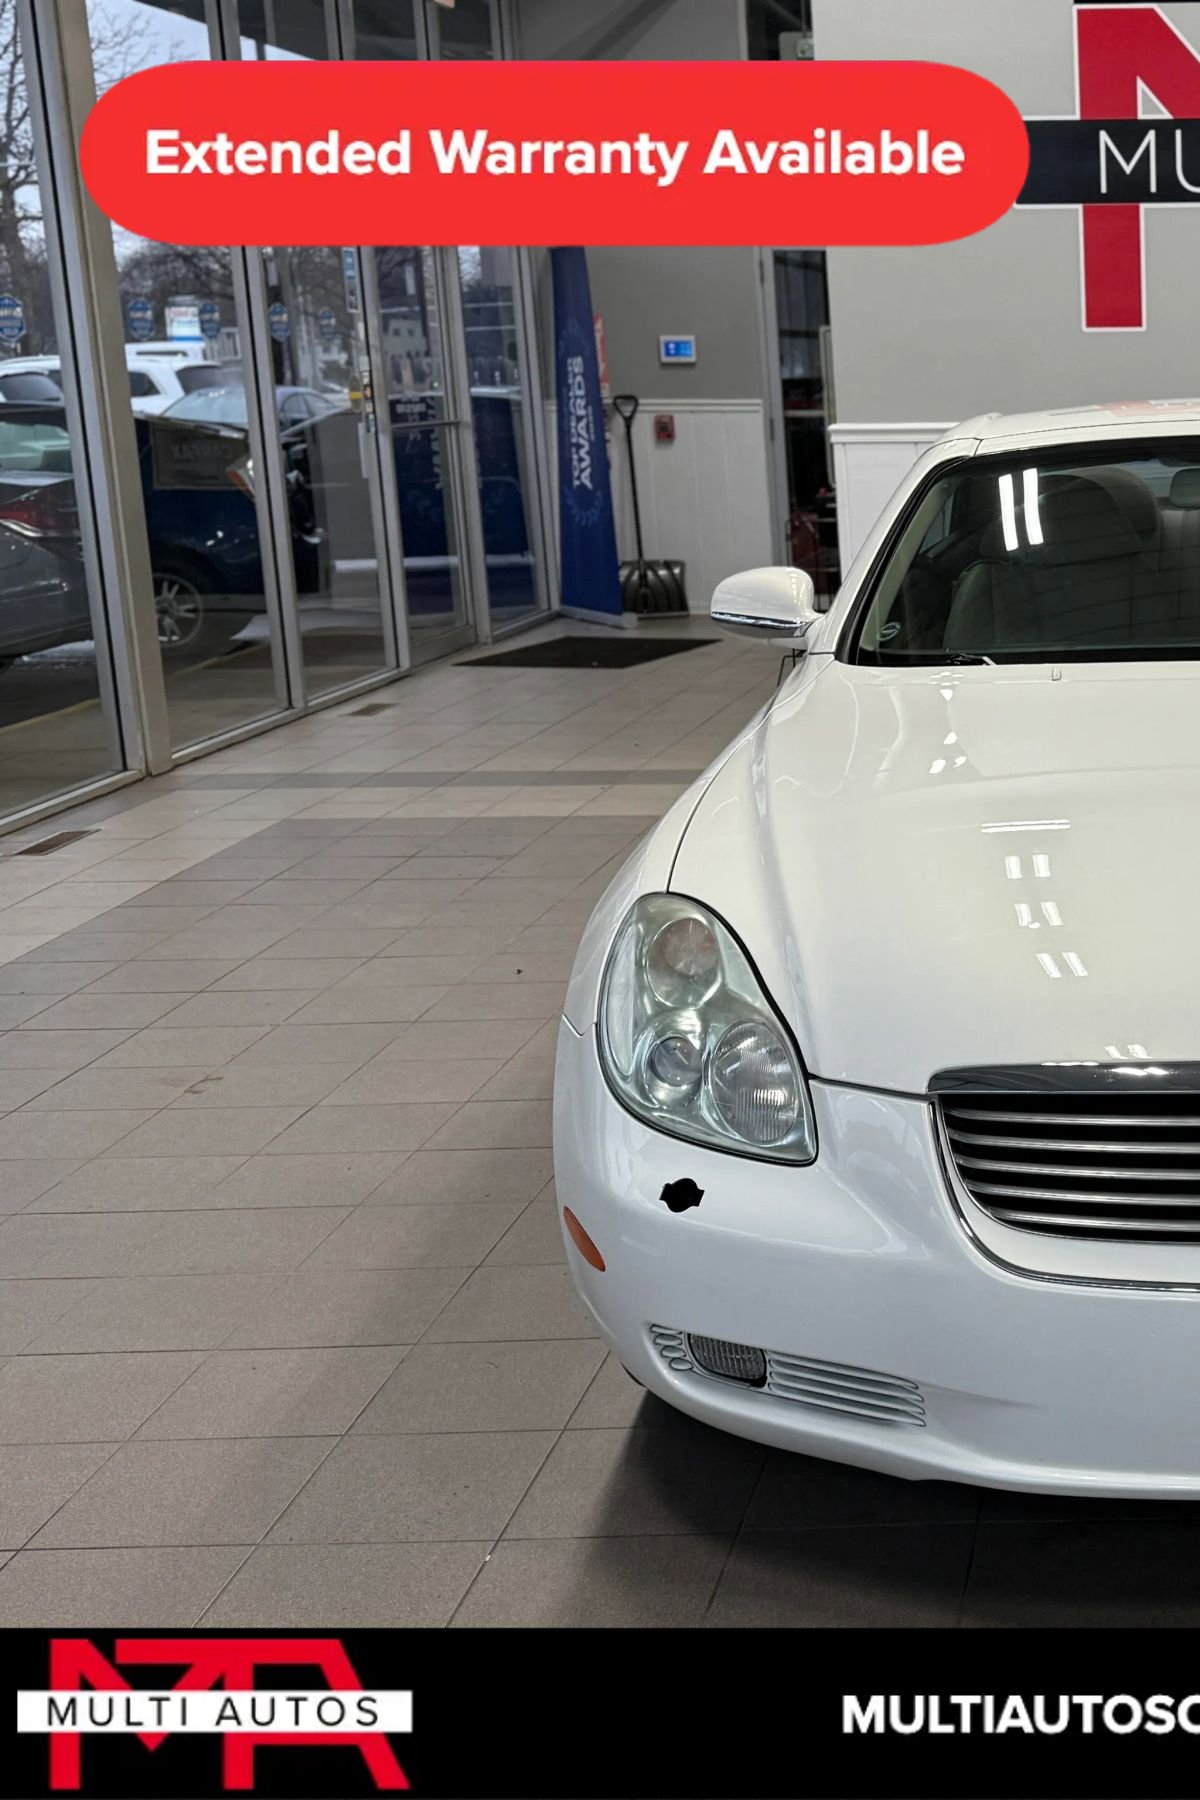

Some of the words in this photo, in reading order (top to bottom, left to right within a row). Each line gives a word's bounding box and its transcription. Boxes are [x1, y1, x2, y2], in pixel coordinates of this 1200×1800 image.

[567, 357, 577, 444] DEALER
[572, 356, 593, 490] AWARDS
[572, 447, 580, 489] TOP
